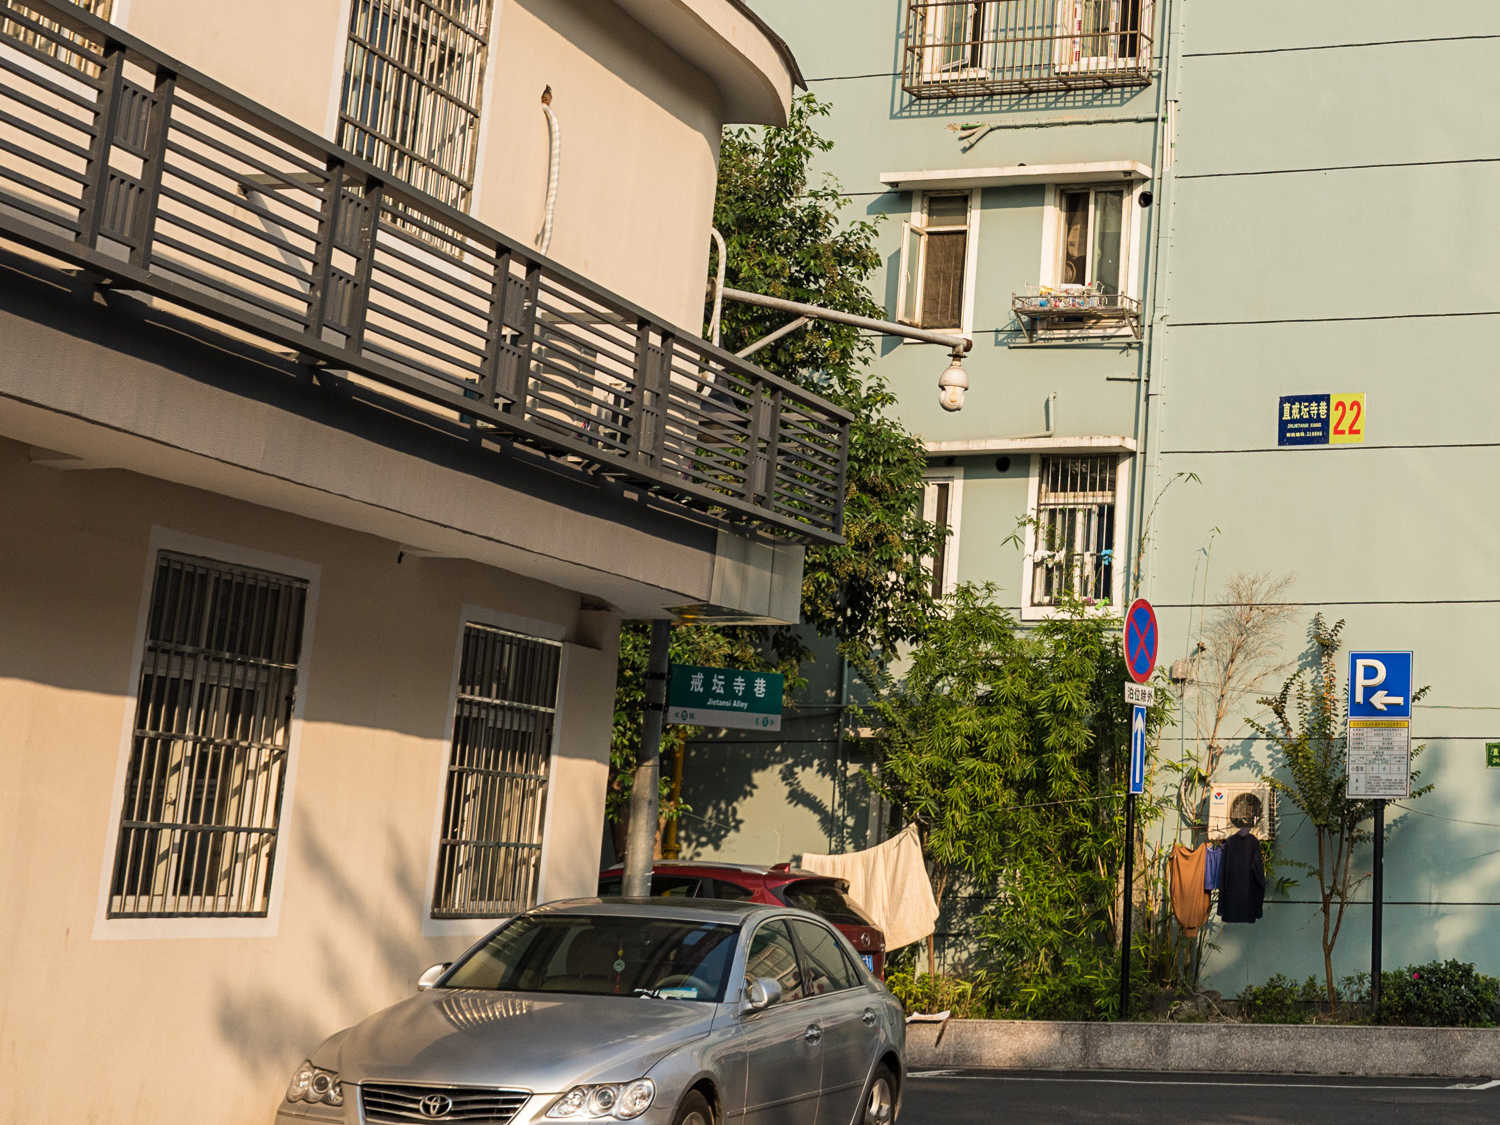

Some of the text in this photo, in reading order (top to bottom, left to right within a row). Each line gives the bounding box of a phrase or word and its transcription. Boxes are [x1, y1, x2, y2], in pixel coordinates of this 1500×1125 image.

[1282, 401, 1328, 420] 直戒坛寺巷
[1333, 400, 1361, 435] 22
[690, 671, 767, 698] 戒坛寺巷
[1355, 658, 1387, 705] P
[707, 697, 748, 710] Jietansi Alley
[1127, 686, 1153, 704] 泊位除外
